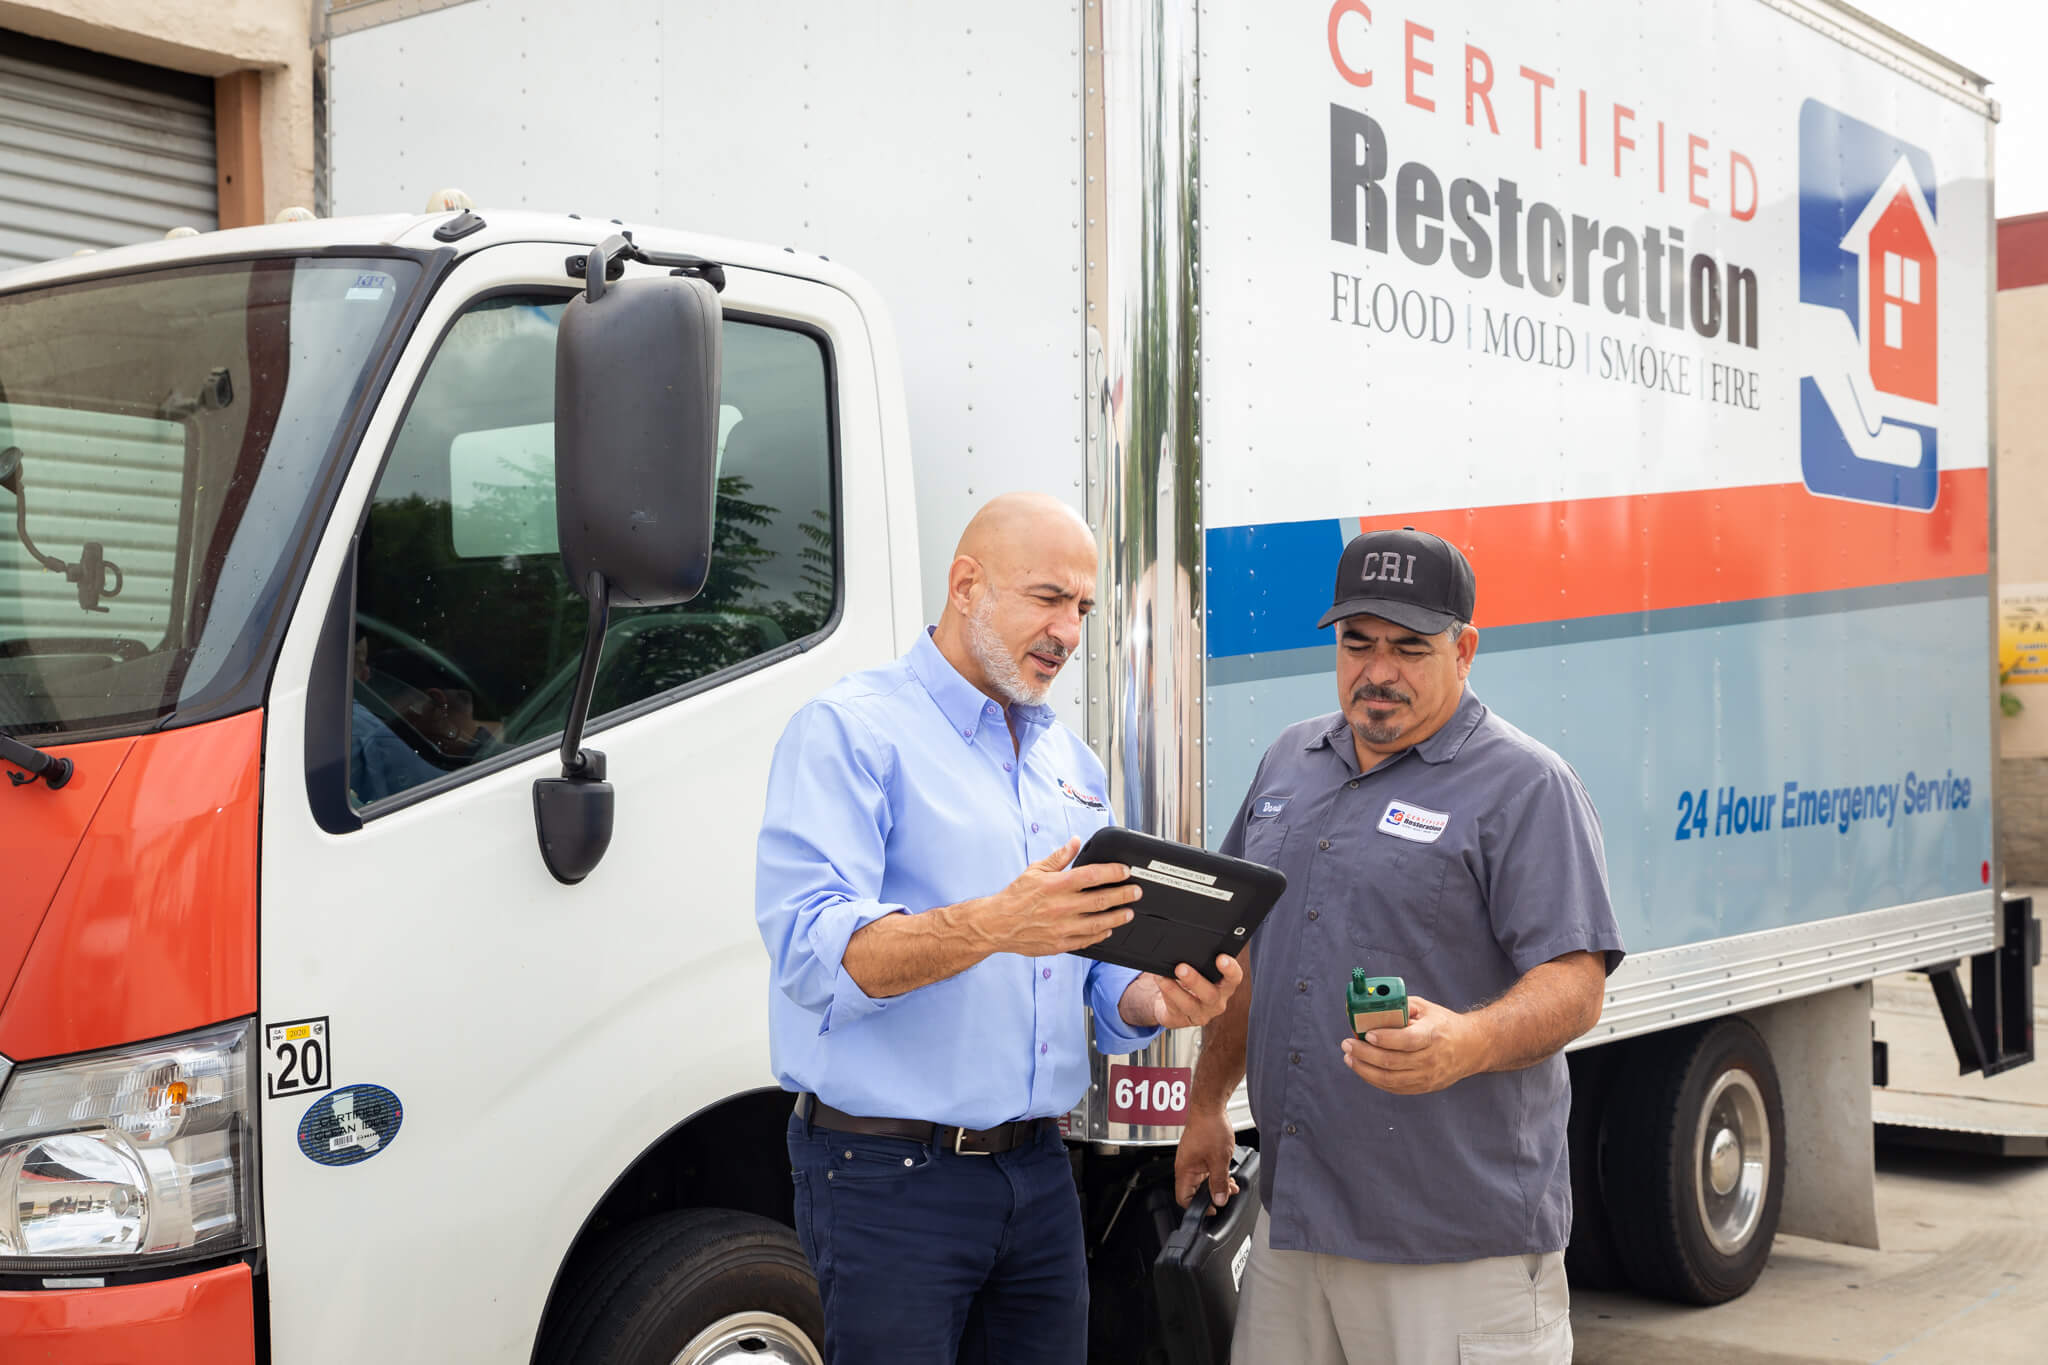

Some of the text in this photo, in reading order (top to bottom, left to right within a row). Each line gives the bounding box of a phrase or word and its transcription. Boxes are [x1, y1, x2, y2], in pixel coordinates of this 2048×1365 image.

[1327, 0, 1760, 222] CERTIFIED
[1329, 101, 1759, 350] Restoration
[1329, 271, 1761, 411] FLOOD MOLD SMOKE FIRE
[1361, 551, 1417, 585] CRI
[1403, 818, 1442, 832] Restoration
[1674, 768, 1971, 841] 24 Hour Emergency Service
[276, 1039, 323, 1090] 20
[1114, 1078, 1187, 1112] 6108
